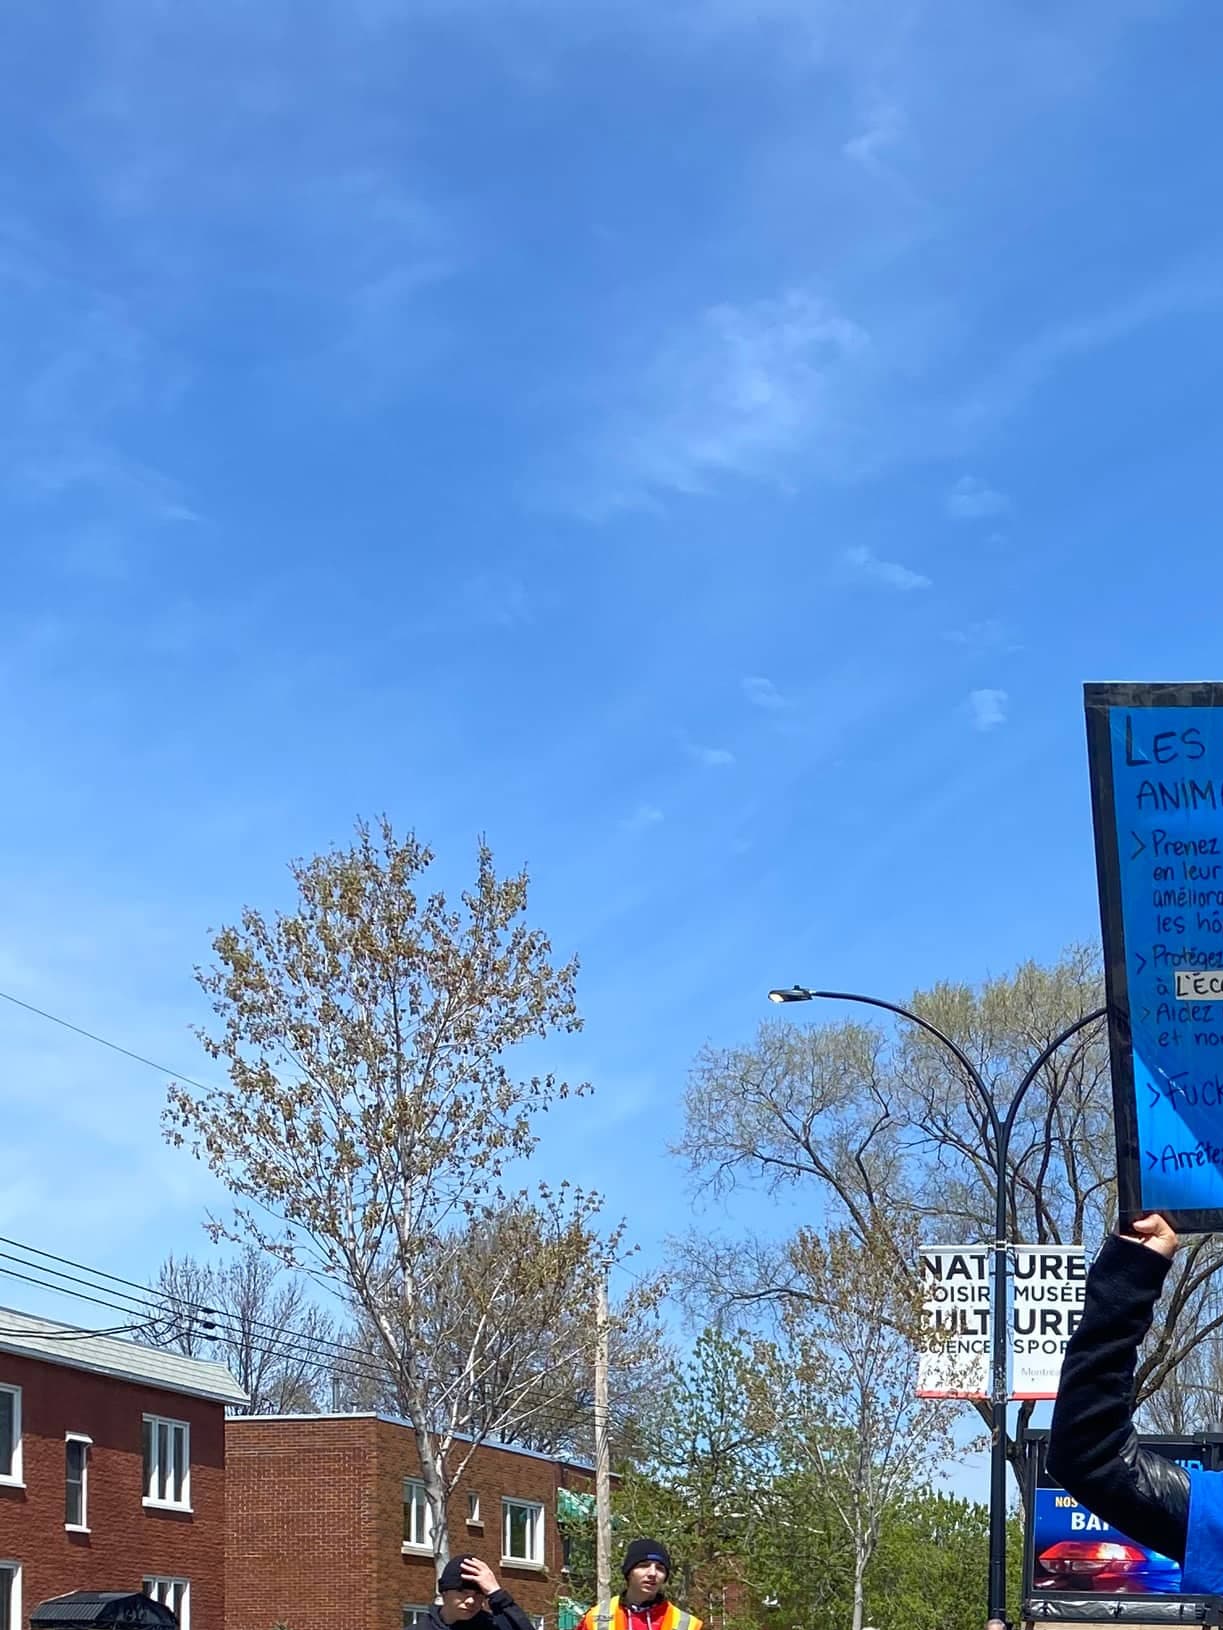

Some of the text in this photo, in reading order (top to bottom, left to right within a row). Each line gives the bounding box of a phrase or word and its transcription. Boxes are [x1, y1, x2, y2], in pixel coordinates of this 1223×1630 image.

[1126, 715, 1205, 766] LES
[1152, 829, 1220, 856] Prenez
[1153, 865, 1174, 881] en
[1183, 862, 1221, 880] leur
[1157, 914, 1185, 934] les
[1156, 978, 1169, 996] à
[1155, 1002, 1211, 1024] Aidez
[1158, 1030, 1180, 1048] et
